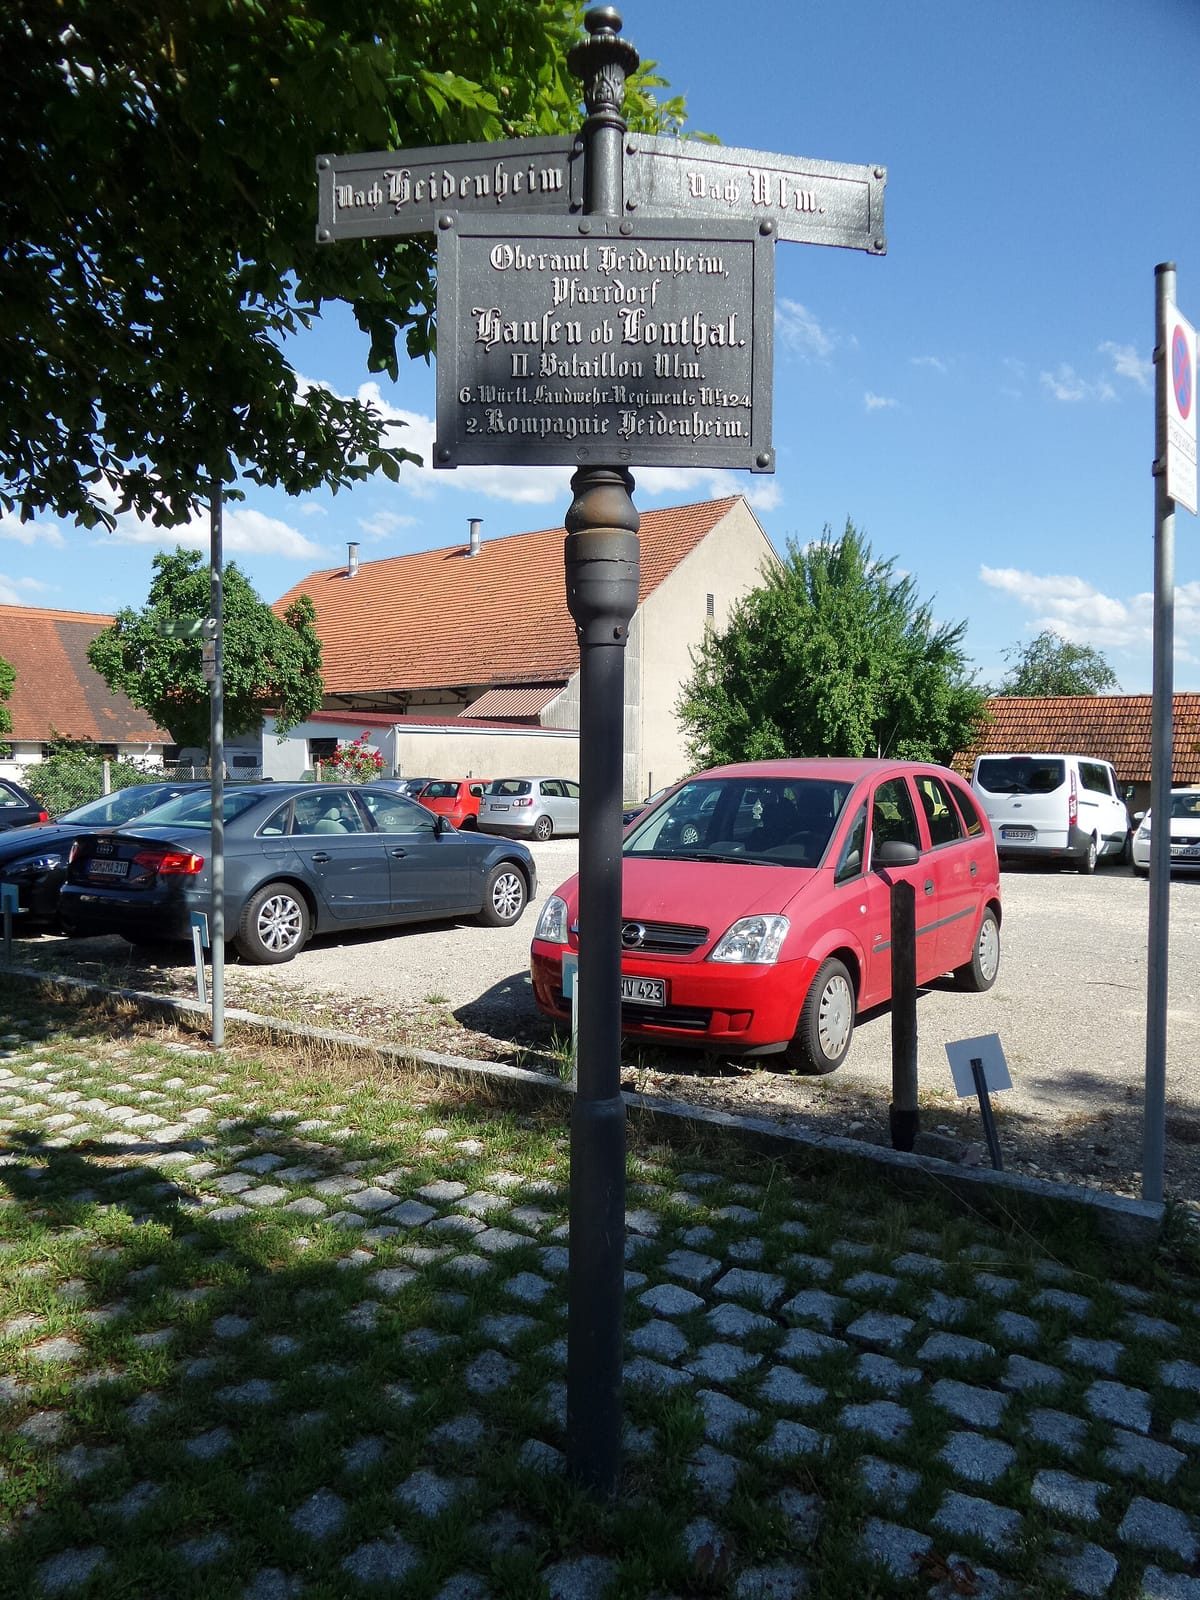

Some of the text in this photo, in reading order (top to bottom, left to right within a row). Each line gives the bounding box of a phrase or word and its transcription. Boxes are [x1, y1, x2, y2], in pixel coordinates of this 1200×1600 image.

[336, 162, 563, 211] Nach Heidenheim
[687, 169, 825, 214] Nach Ulm.
[490, 244, 729, 279] Oberamt Heidenheim,
[551, 276, 661, 308] Pfarrdorf
[590, 325, 613, 345] ob
[617, 307, 746, 353] Lonthal.
[510, 351, 706, 380] II. Bataillon Ulm.
[459, 386, 476, 403] 6.
[477, 385, 532, 404] Württ.
[466, 408, 749, 442] 2. Kompagnie Heidenheim.
[639, 981, 663, 999] 423
